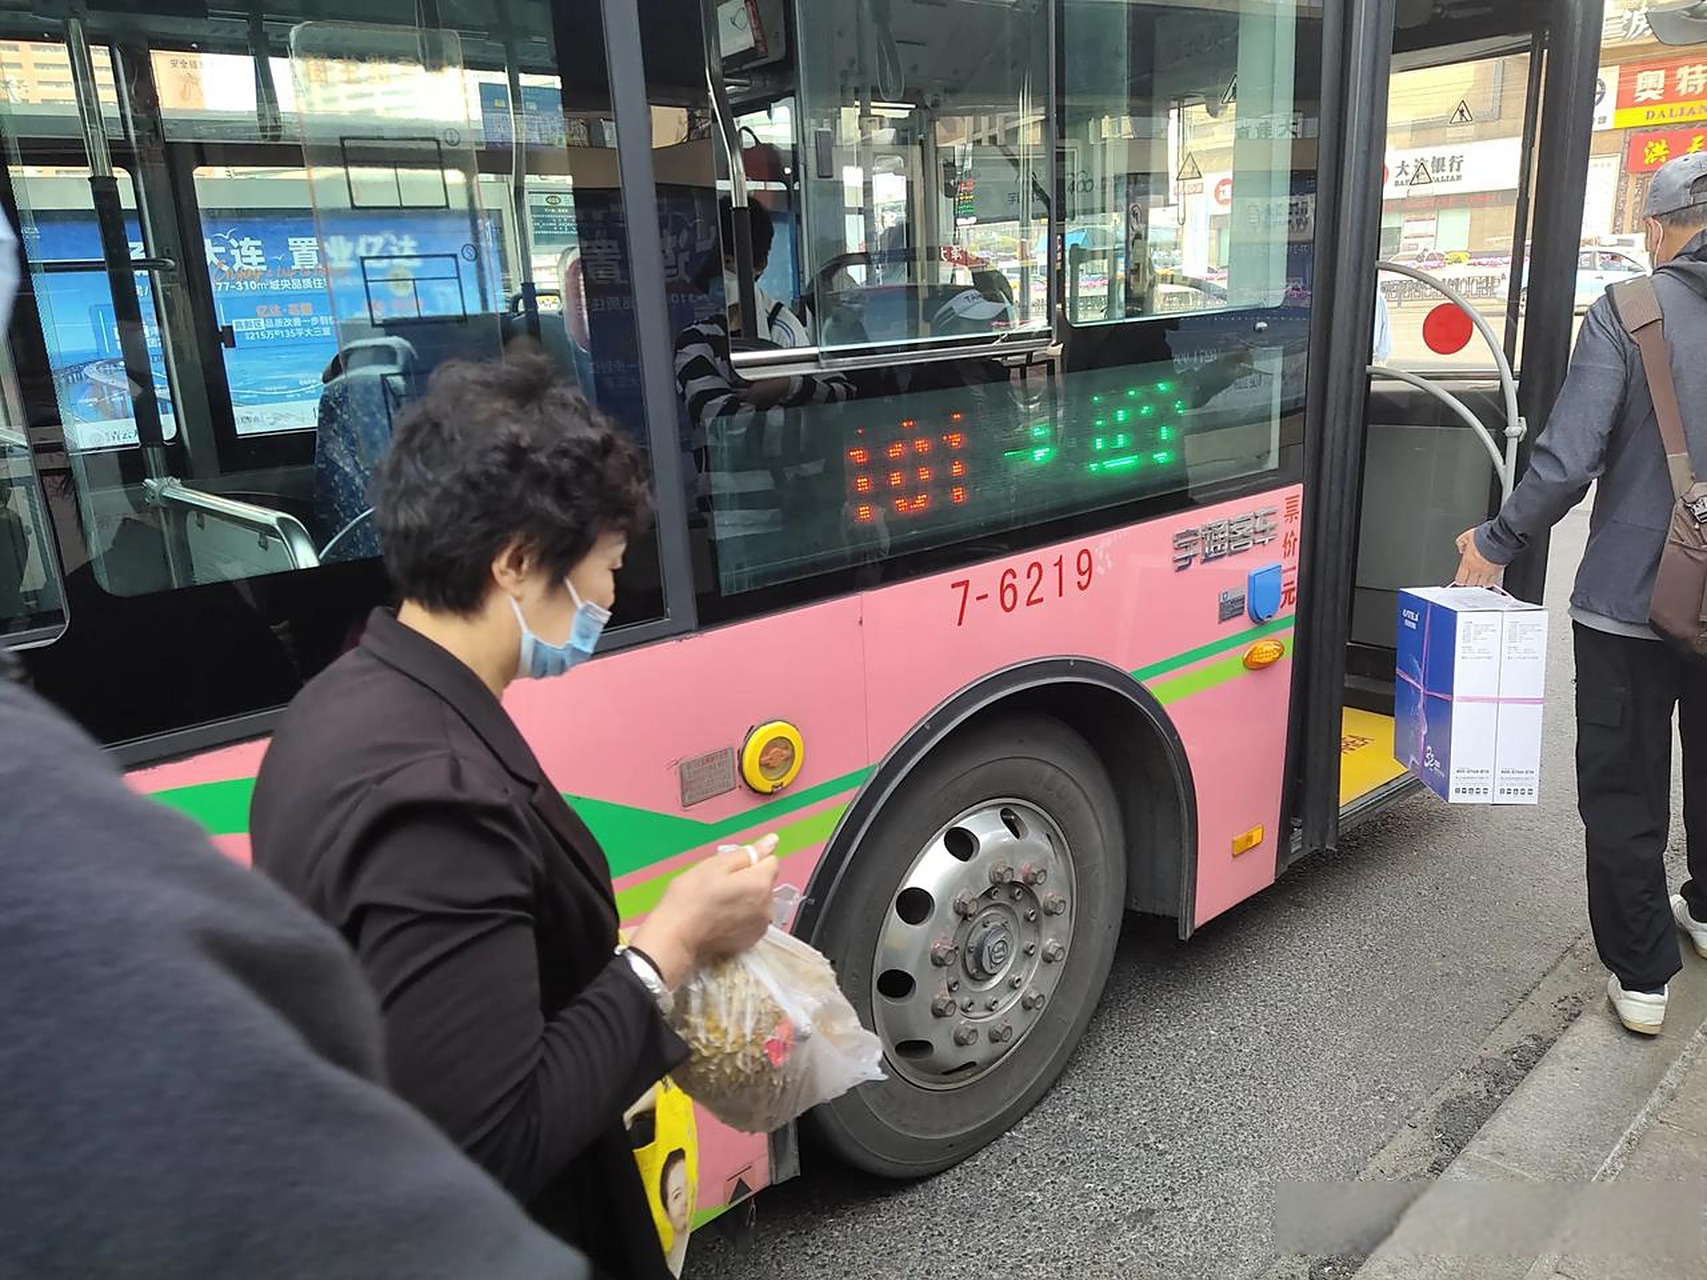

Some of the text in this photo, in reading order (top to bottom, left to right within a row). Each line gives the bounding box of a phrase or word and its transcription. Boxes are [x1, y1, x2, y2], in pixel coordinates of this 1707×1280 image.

[1173, 506, 1278, 573] 宇通客车
[951, 549, 1093, 626] 7-6219
